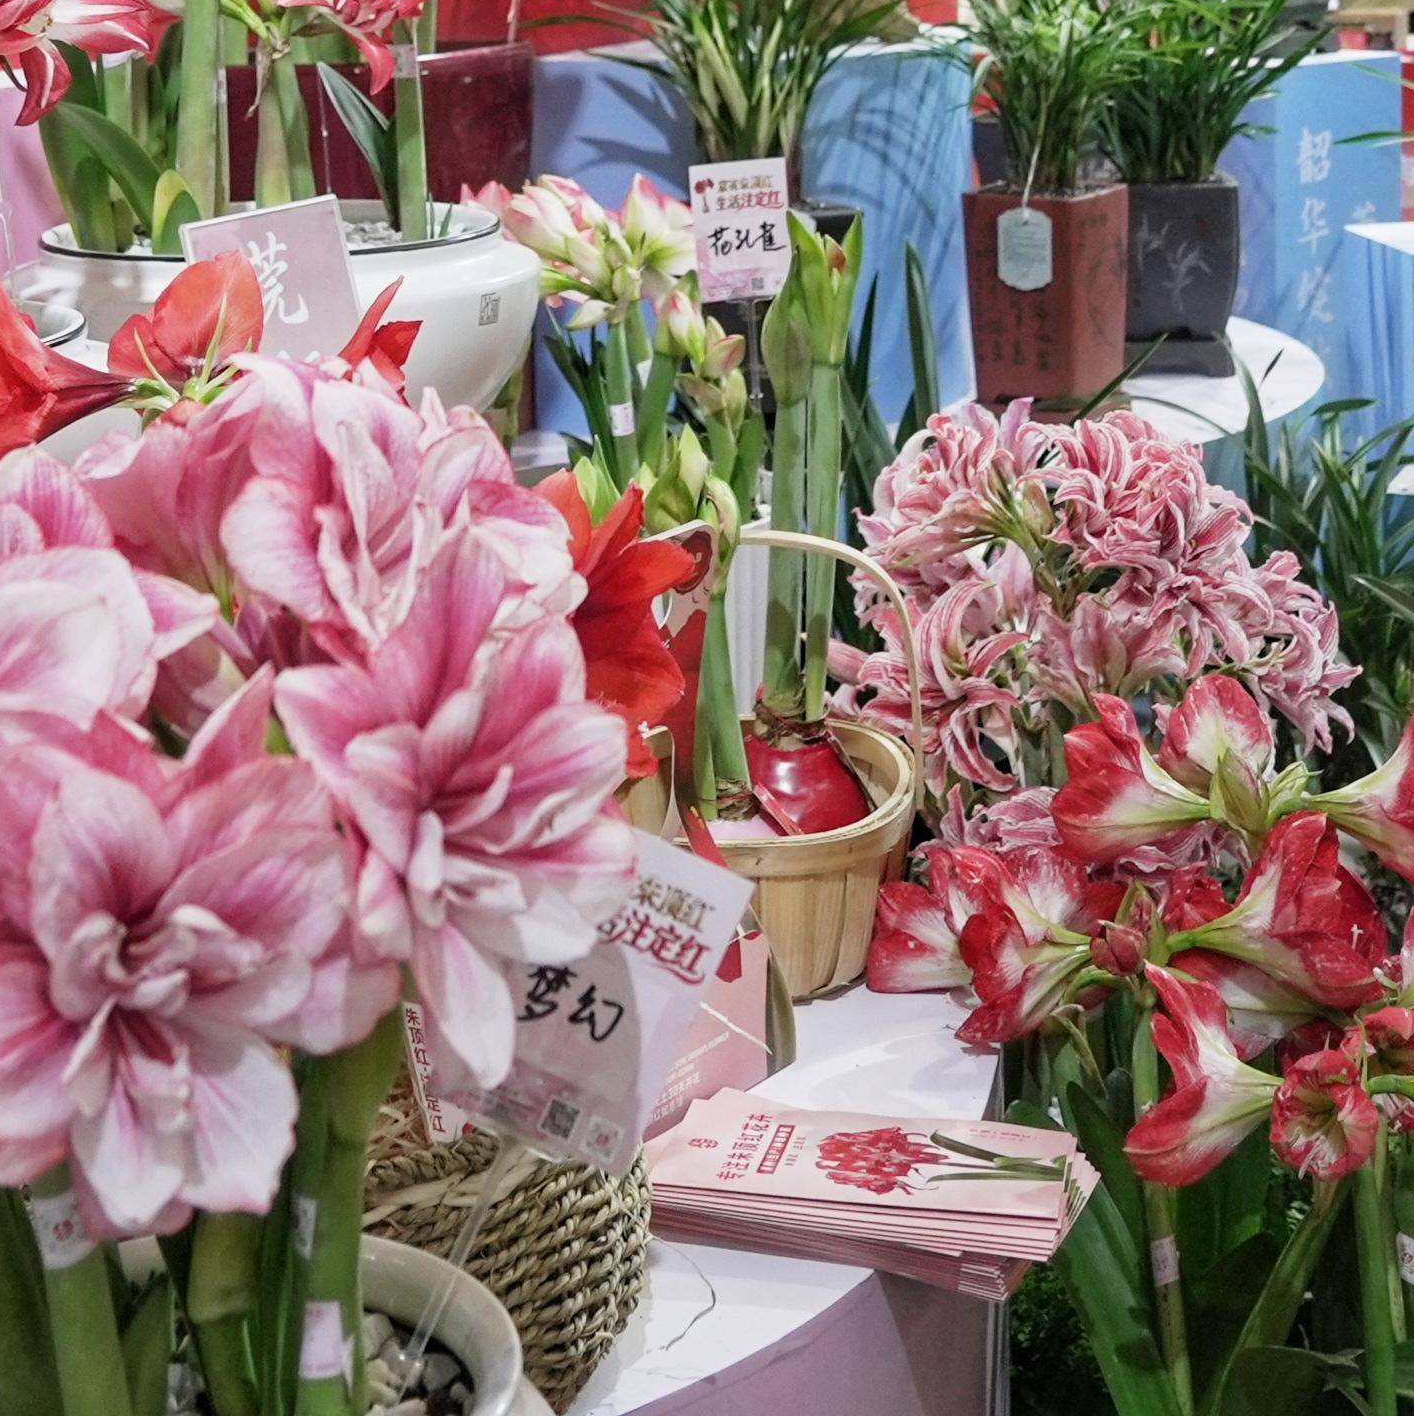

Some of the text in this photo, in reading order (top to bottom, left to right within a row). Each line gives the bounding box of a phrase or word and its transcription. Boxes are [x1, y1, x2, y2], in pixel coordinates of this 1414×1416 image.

[715, 190, 784, 212] 生活注定红
[707, 221, 788, 257] 花孔雀
[517, 965, 624, 1042] 梦幻
